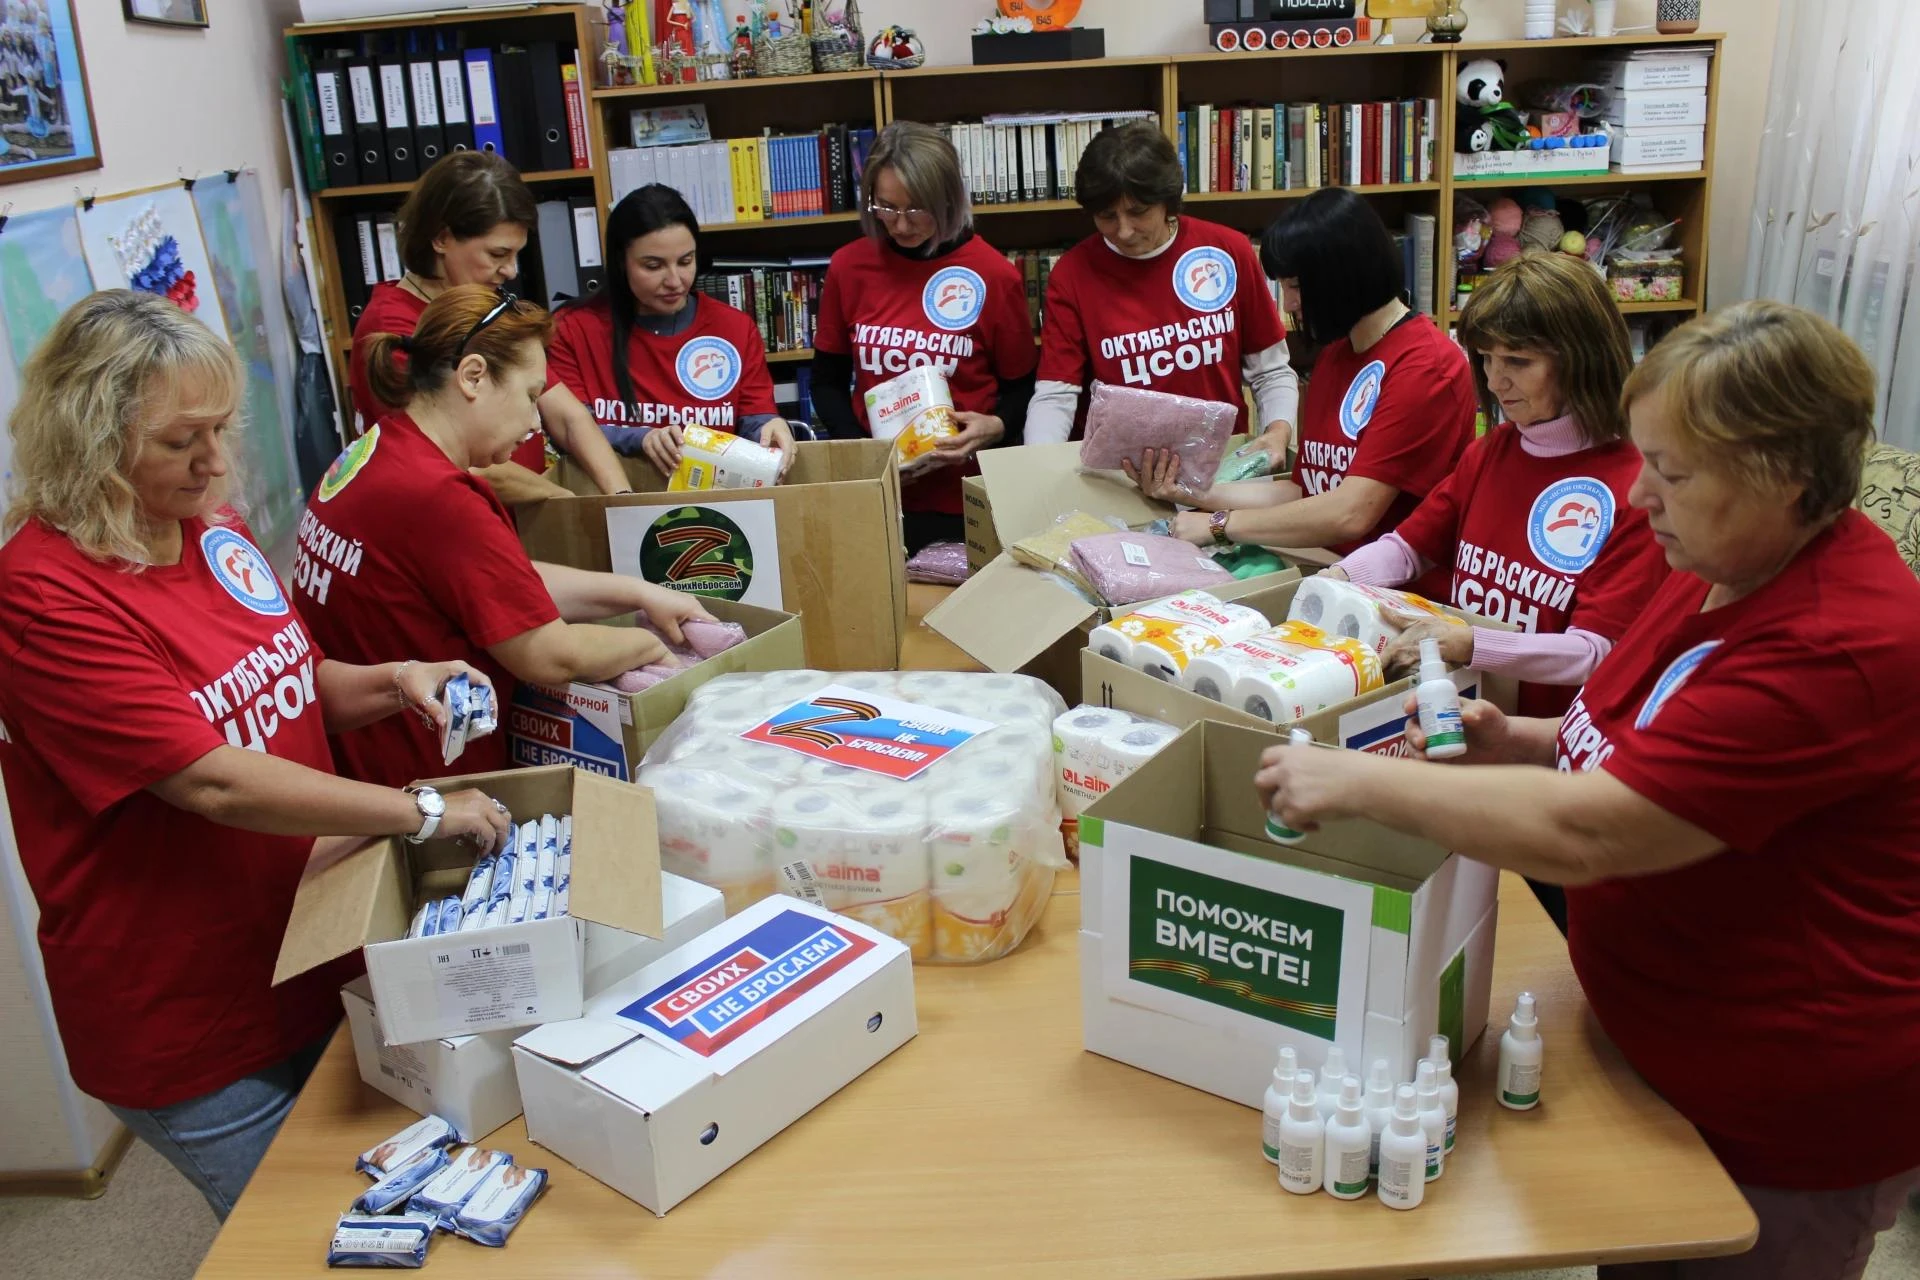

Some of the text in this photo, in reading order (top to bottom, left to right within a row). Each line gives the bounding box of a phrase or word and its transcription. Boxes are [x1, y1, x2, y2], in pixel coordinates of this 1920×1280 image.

[1036, 16, 1052, 25] 1945
[1101, 306, 1235, 360] ОКТЯБРЬСКИЙ
[1120, 337, 1224, 386] ЦСОН
[886, 391, 921, 415] Laima
[293, 543, 333, 606] СОН
[1456, 539, 1577, 613] ТЯБРЬСКИЙ
[1451, 573, 1540, 635] СОН
[511, 711, 561, 742] СВОИХ
[893, 732, 917, 745] НЕ
[899, 718, 953, 736] СВОИХ
[520, 742, 539, 762] НЕ
[846, 738, 928, 763] БРОСАЕМ!
[1074, 775, 1111, 794] Laim
[811, 862, 882, 883] Laima
[1155, 887, 1314, 952] ПОМОЖЕМ
[1155, 917, 1311, 988] ВМЕСТЕ!
[667, 961, 751, 1013] СВОИХ
[707, 937, 839, 1023] НЕ БРОСАЕМ
